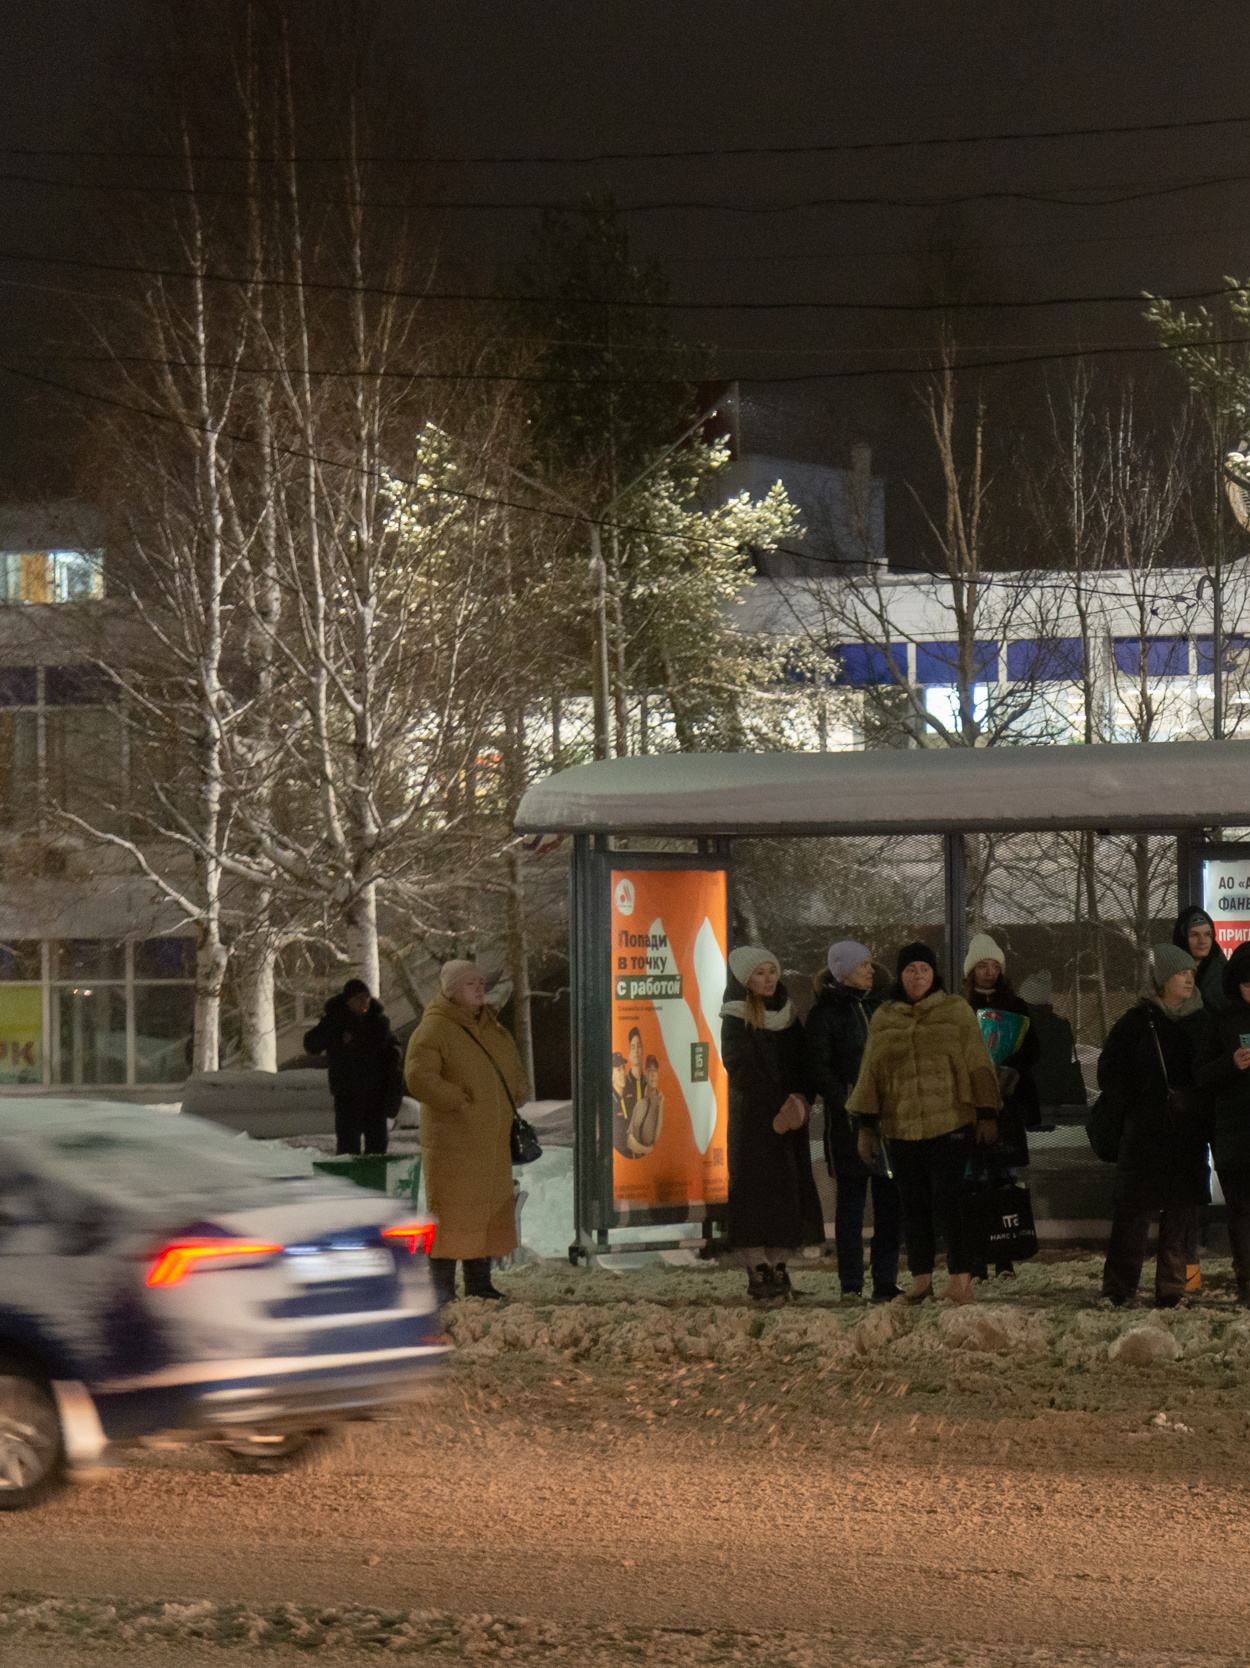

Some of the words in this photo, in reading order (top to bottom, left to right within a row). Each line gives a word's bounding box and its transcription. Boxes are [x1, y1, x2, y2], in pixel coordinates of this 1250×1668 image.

[1218, 875, 1235, 890] АО
[618, 930, 668, 952] Попади
[618, 957, 628, 970] в
[630, 957, 668, 974] точку
[616, 982, 627, 996] с
[629, 976, 681, 999] работой
